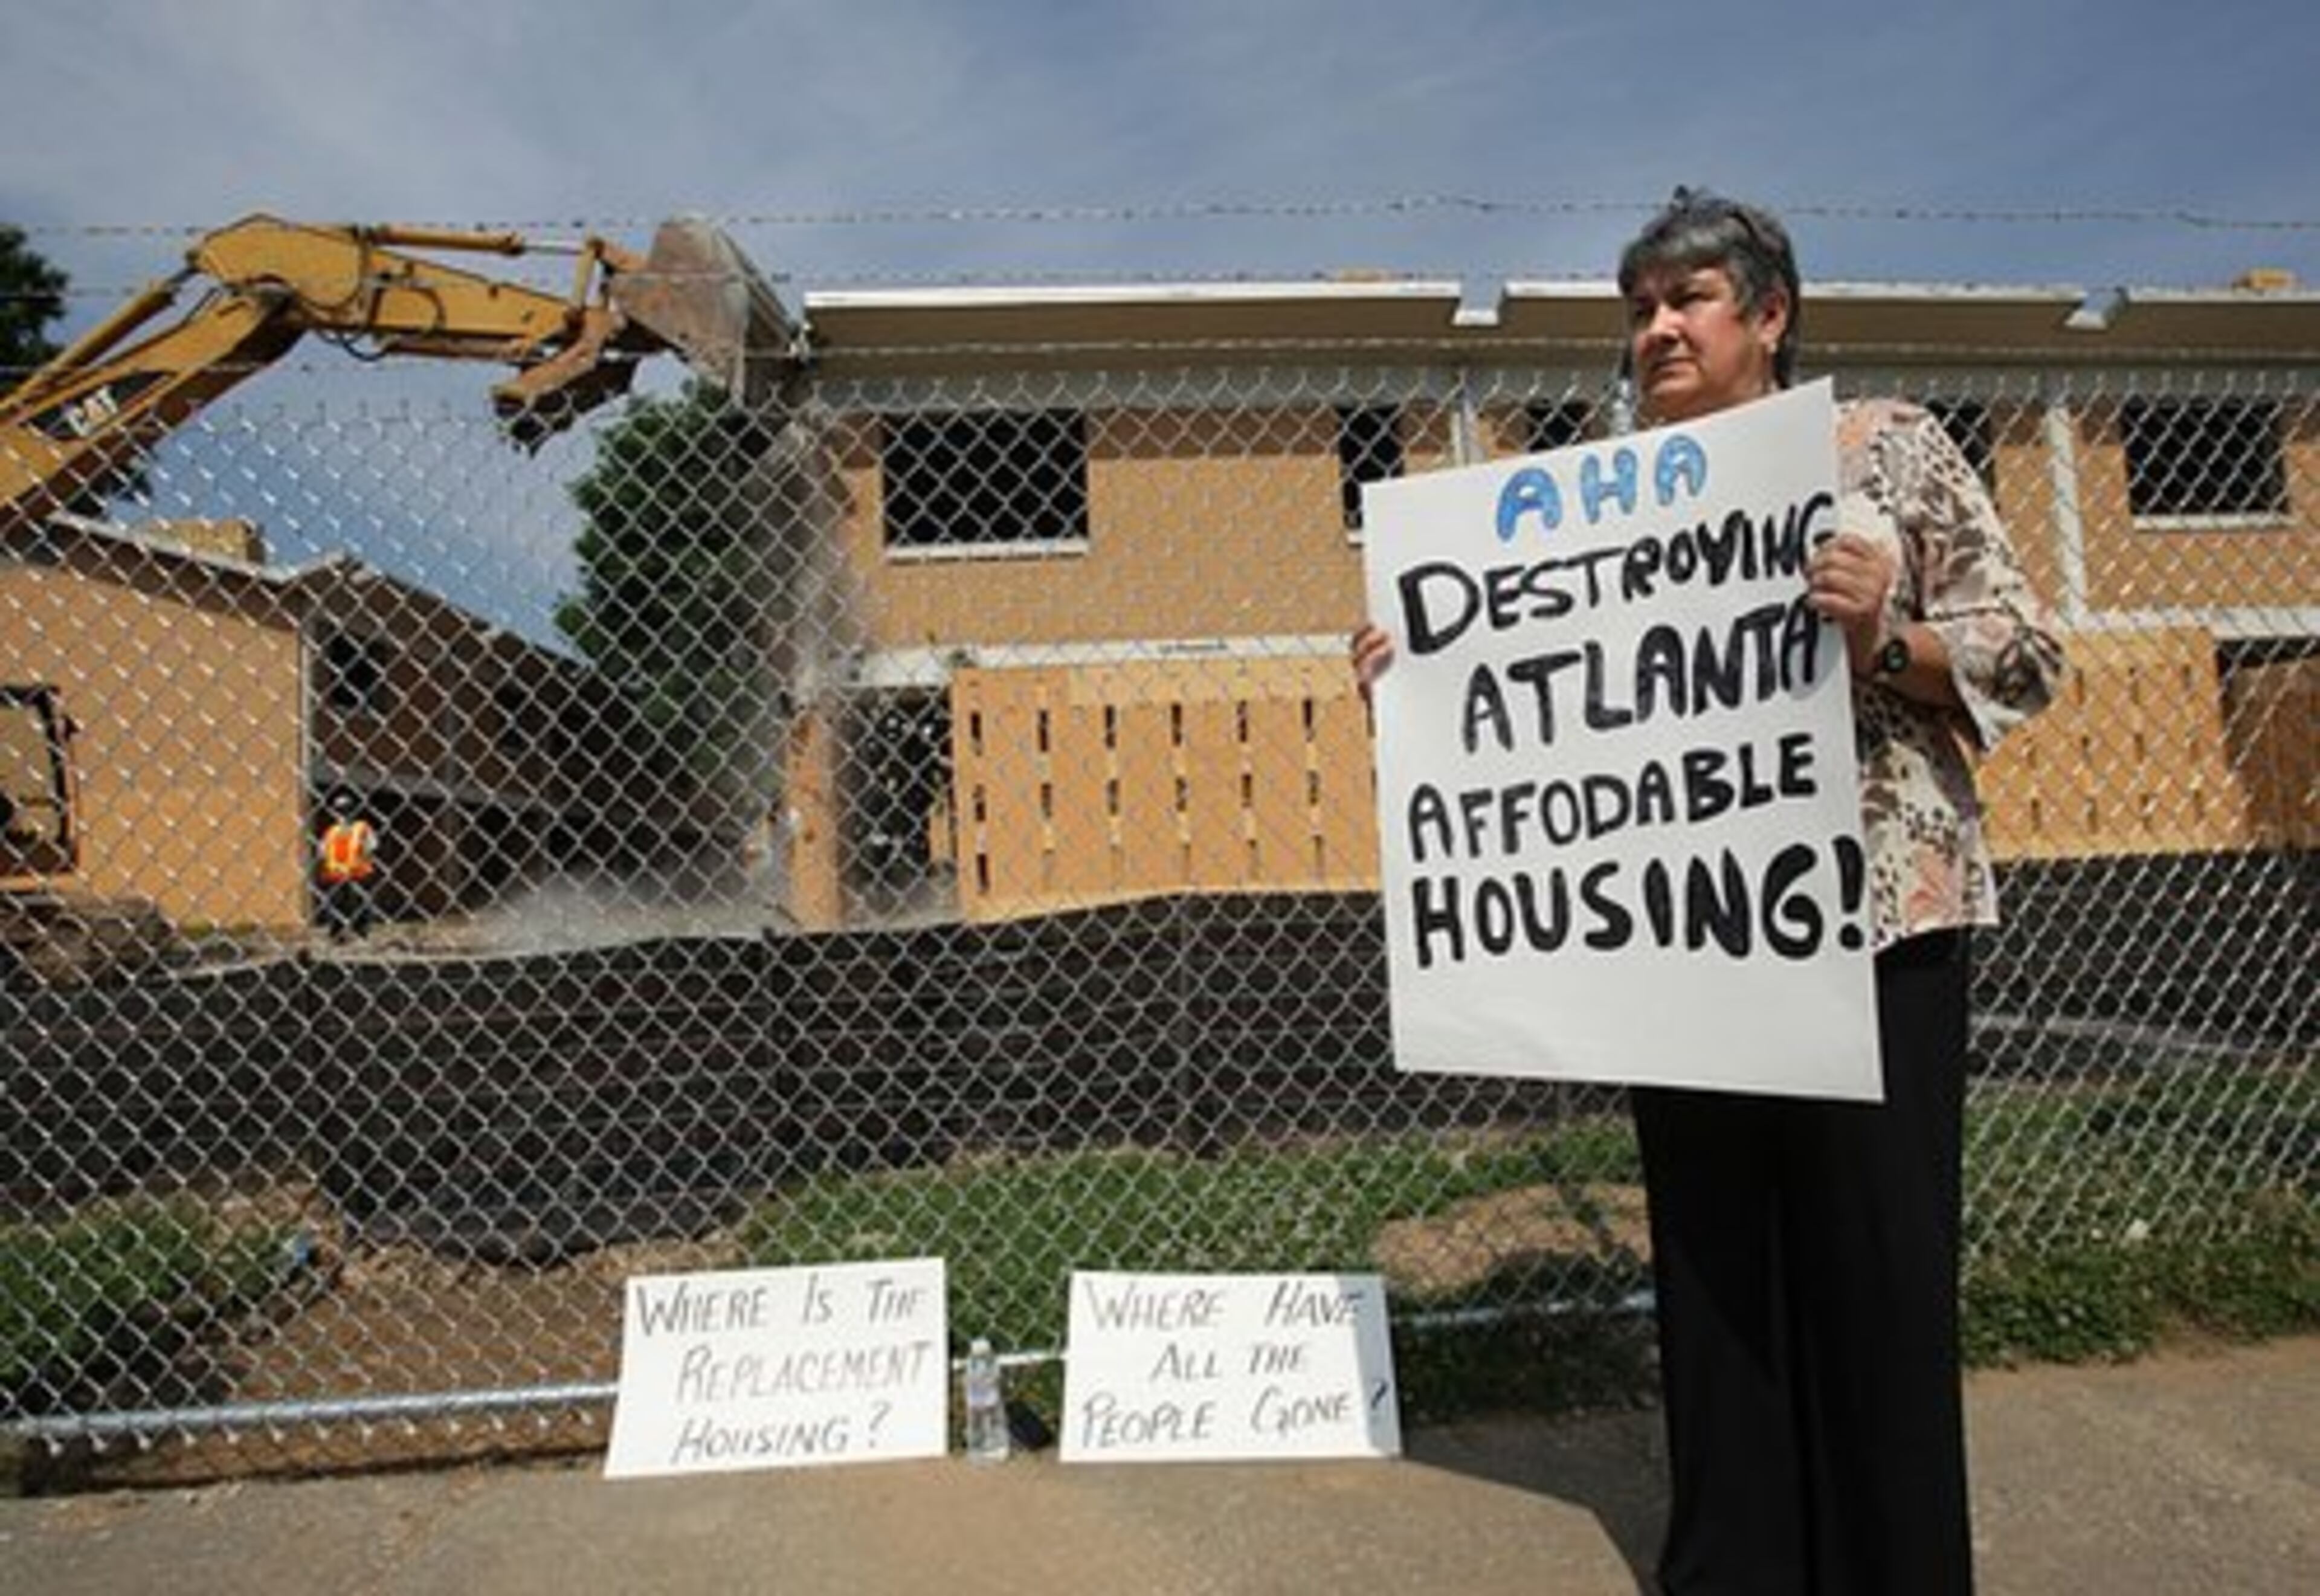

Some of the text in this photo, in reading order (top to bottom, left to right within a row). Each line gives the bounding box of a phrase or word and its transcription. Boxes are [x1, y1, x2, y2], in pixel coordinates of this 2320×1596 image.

[61, 384, 118, 437] CAT
[1497, 434, 1707, 542] AHA
[1463, 593, 1820, 753] ATLANTA
[1408, 734, 1815, 863] AFFODABLE
[1413, 835, 1865, 968] HOUSING!
[636, 1281, 768, 1336] WHERE
[1084, 1279, 1364, 1330] WHERE HAVE
[675, 1340, 932, 1403] REPLACEMENT
[1151, 1343, 1309, 1381] ALL THE
[1083, 1392, 1214, 1449] PEOPLE
